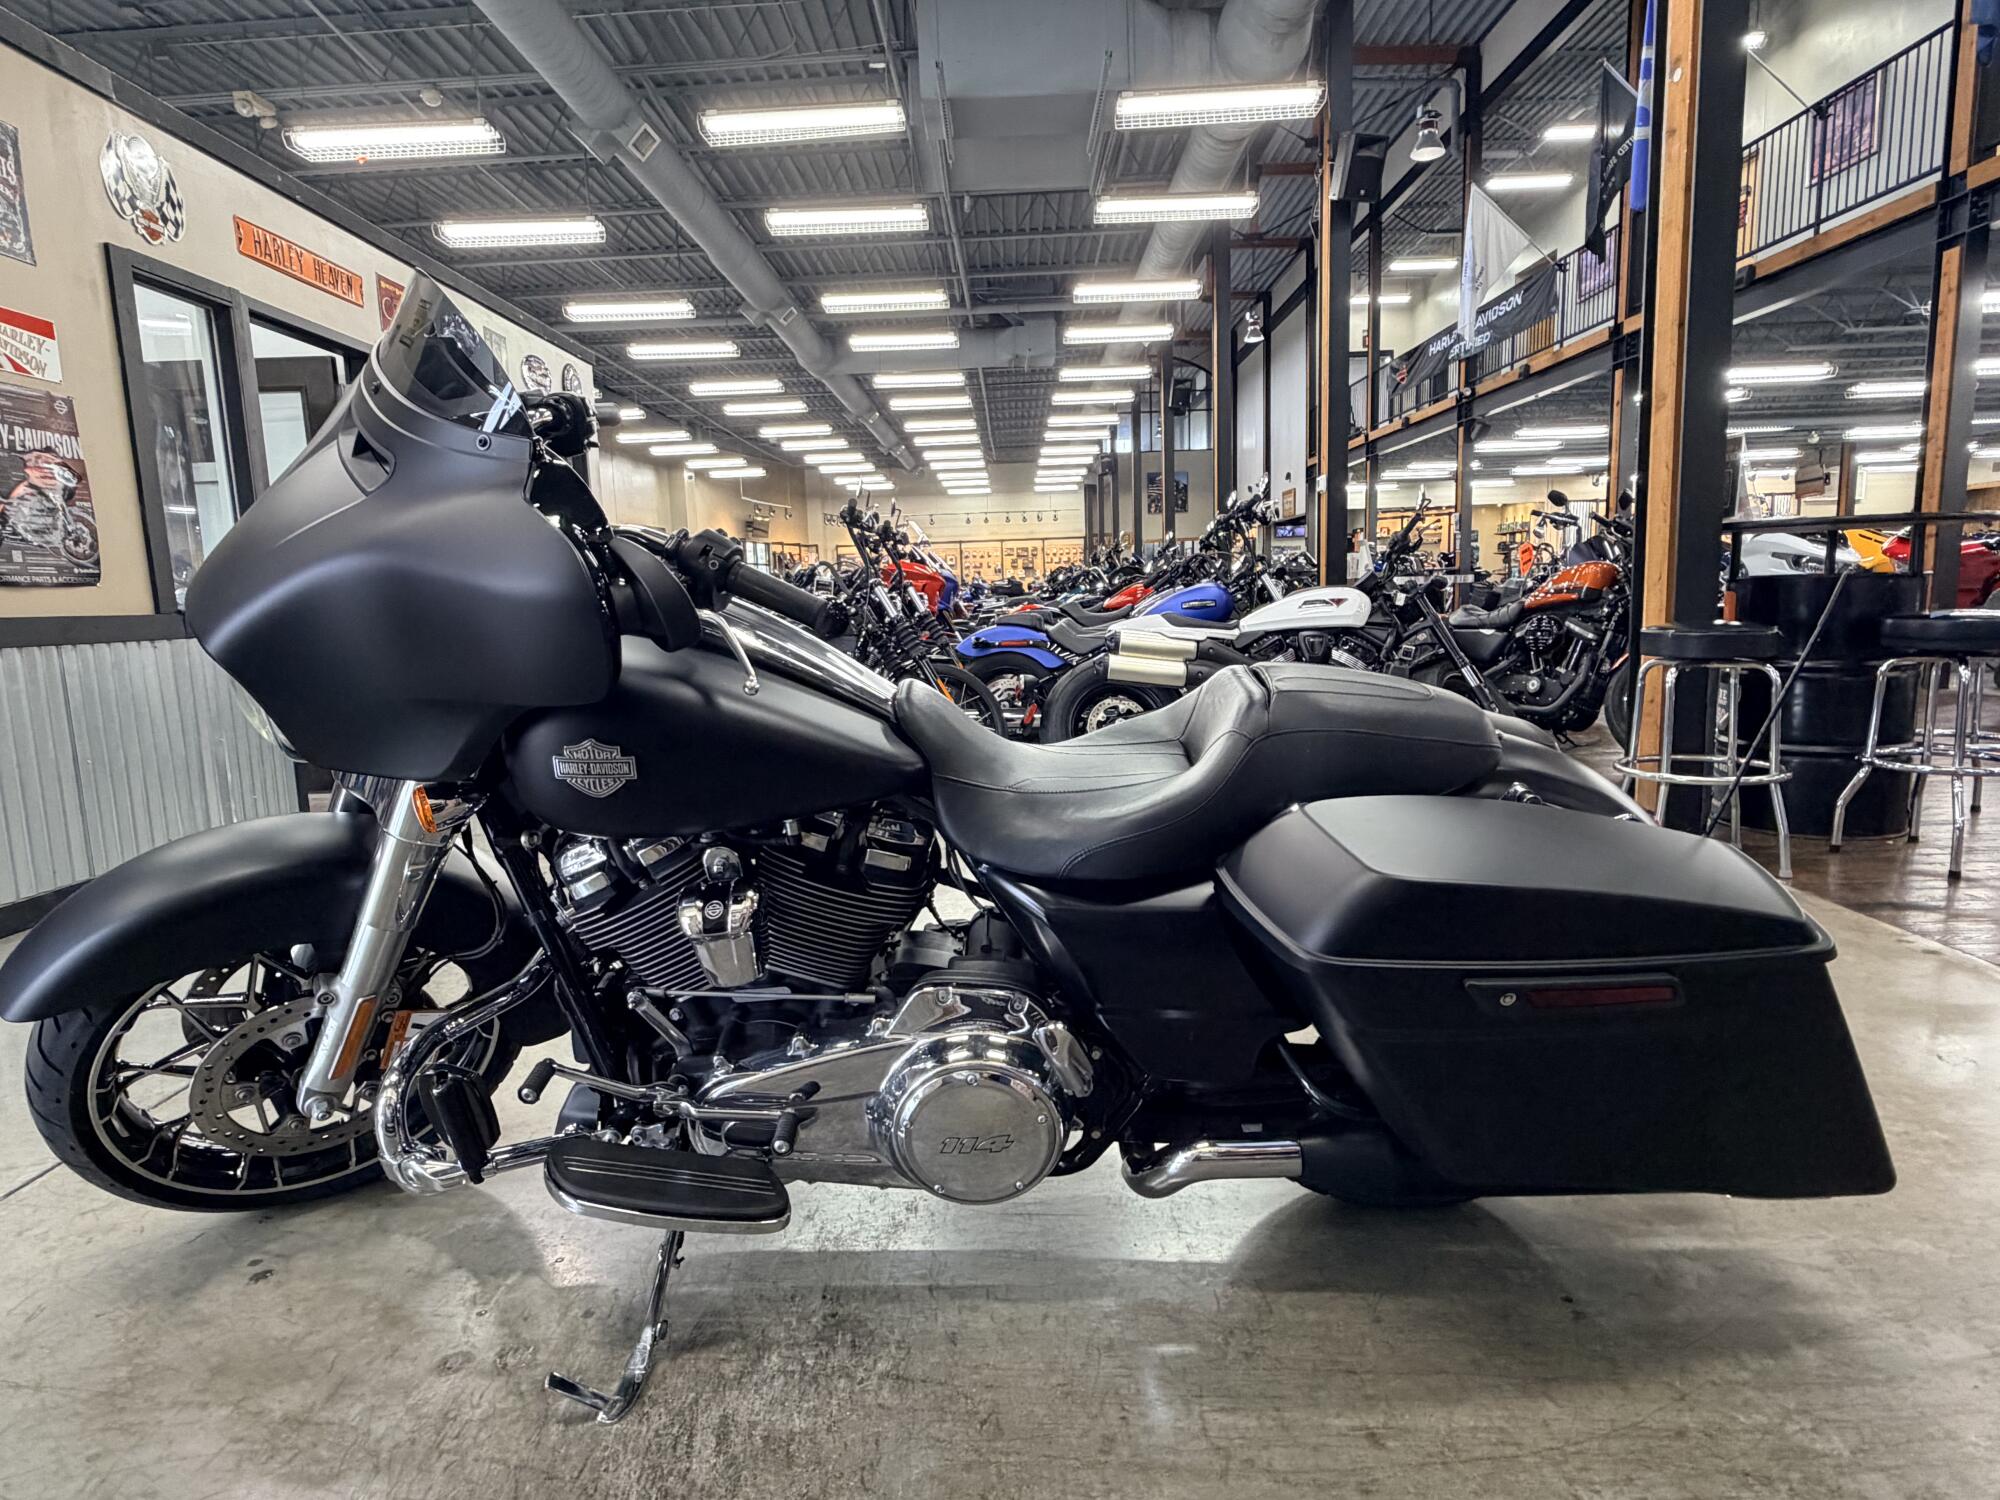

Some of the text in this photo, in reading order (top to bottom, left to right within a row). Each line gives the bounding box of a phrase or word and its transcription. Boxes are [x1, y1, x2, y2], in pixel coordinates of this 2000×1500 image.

[252, 226, 355, 300] HARLEY HEAVEN
[0, 423, 83, 460] Y-DAVIDSON
[573, 746, 612, 760] MOTOR
[559, 761, 630, 775] HARLEY-DAVIDSON
[577, 778, 614, 792] CYCLES
[939, 1134, 1015, 1155] 114
